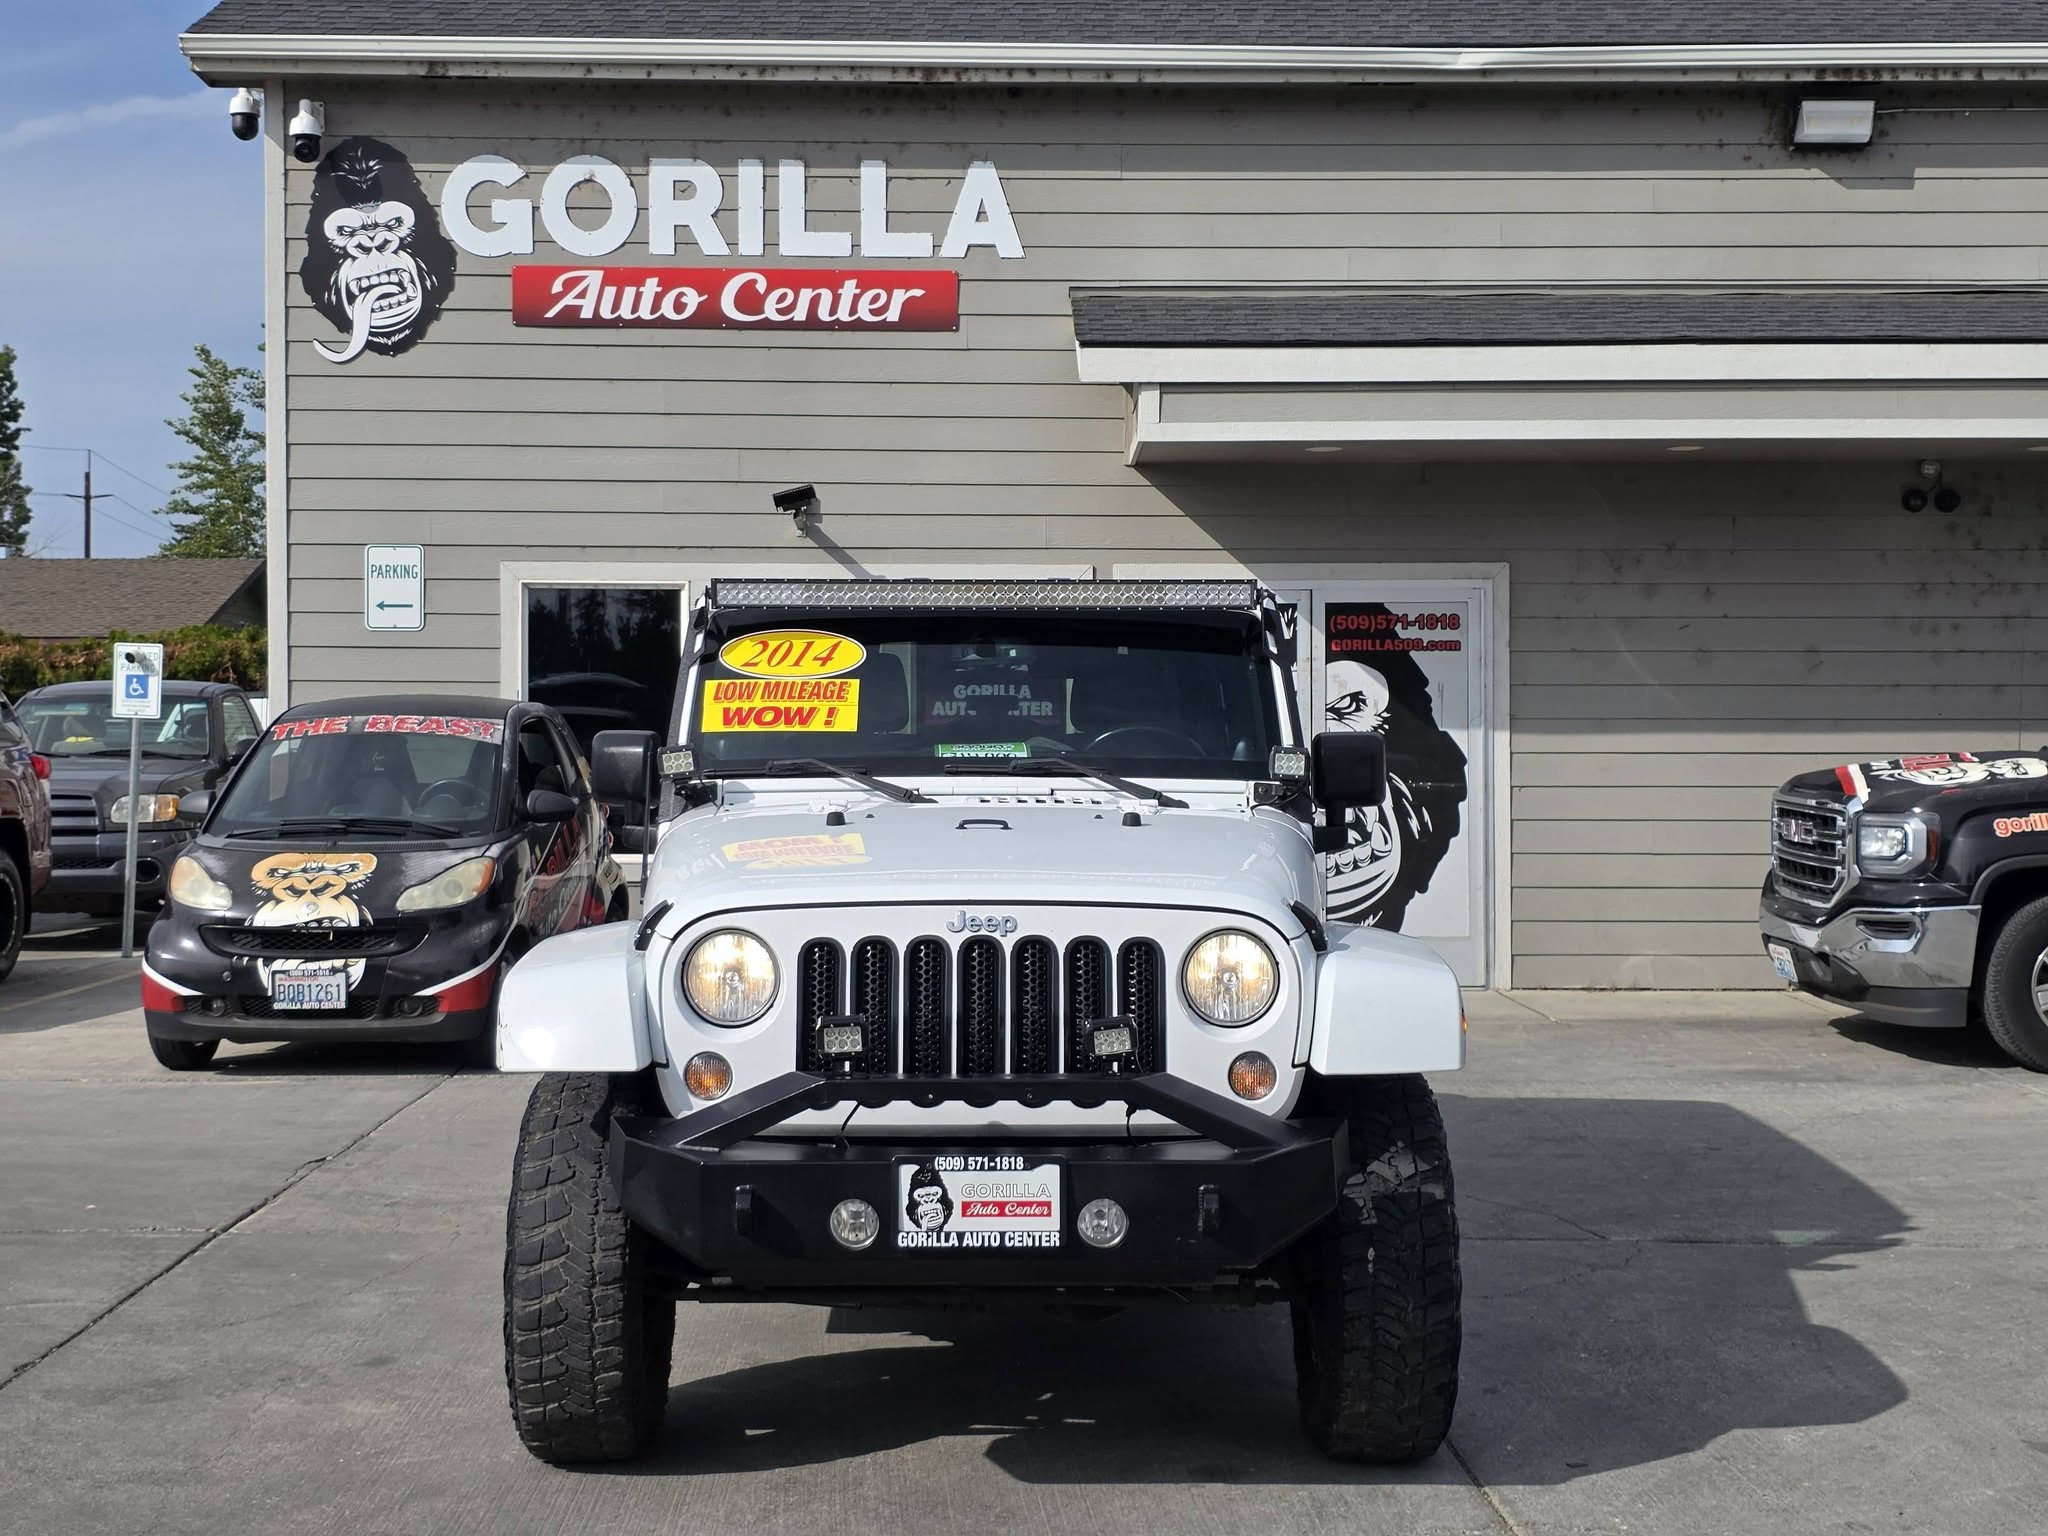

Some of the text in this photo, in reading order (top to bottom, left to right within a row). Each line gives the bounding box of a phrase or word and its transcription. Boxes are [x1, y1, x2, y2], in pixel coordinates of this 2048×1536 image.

[441, 154, 1025, 258] GORILLA
[544, 269, 925, 323] Auto Center
[370, 564, 419, 579] PARKING
[1330, 613, 1461, 632] (509)571-1818
[740, 639, 843, 668] 2014
[1331, 638, 1462, 652] GORILLA509.com
[713, 681, 852, 702] LOW MILEAGE
[953, 684, 1032, 699] GORILLA
[722, 706, 839, 728] WOW !
[932, 701, 977, 716] AUT
[270, 715, 504, 741] THE BEAST
[946, 909, 1018, 937] Jeep
[302, 1001, 320, 1009] AUTO
[934, 1156, 1024, 1170] (509) 571-1818
[961, 1183, 1052, 1198] GORILLA
[966, 1202, 1050, 1216] Auto Center
[898, 1231, 1060, 1248] GORILLA AUTO CENTER
